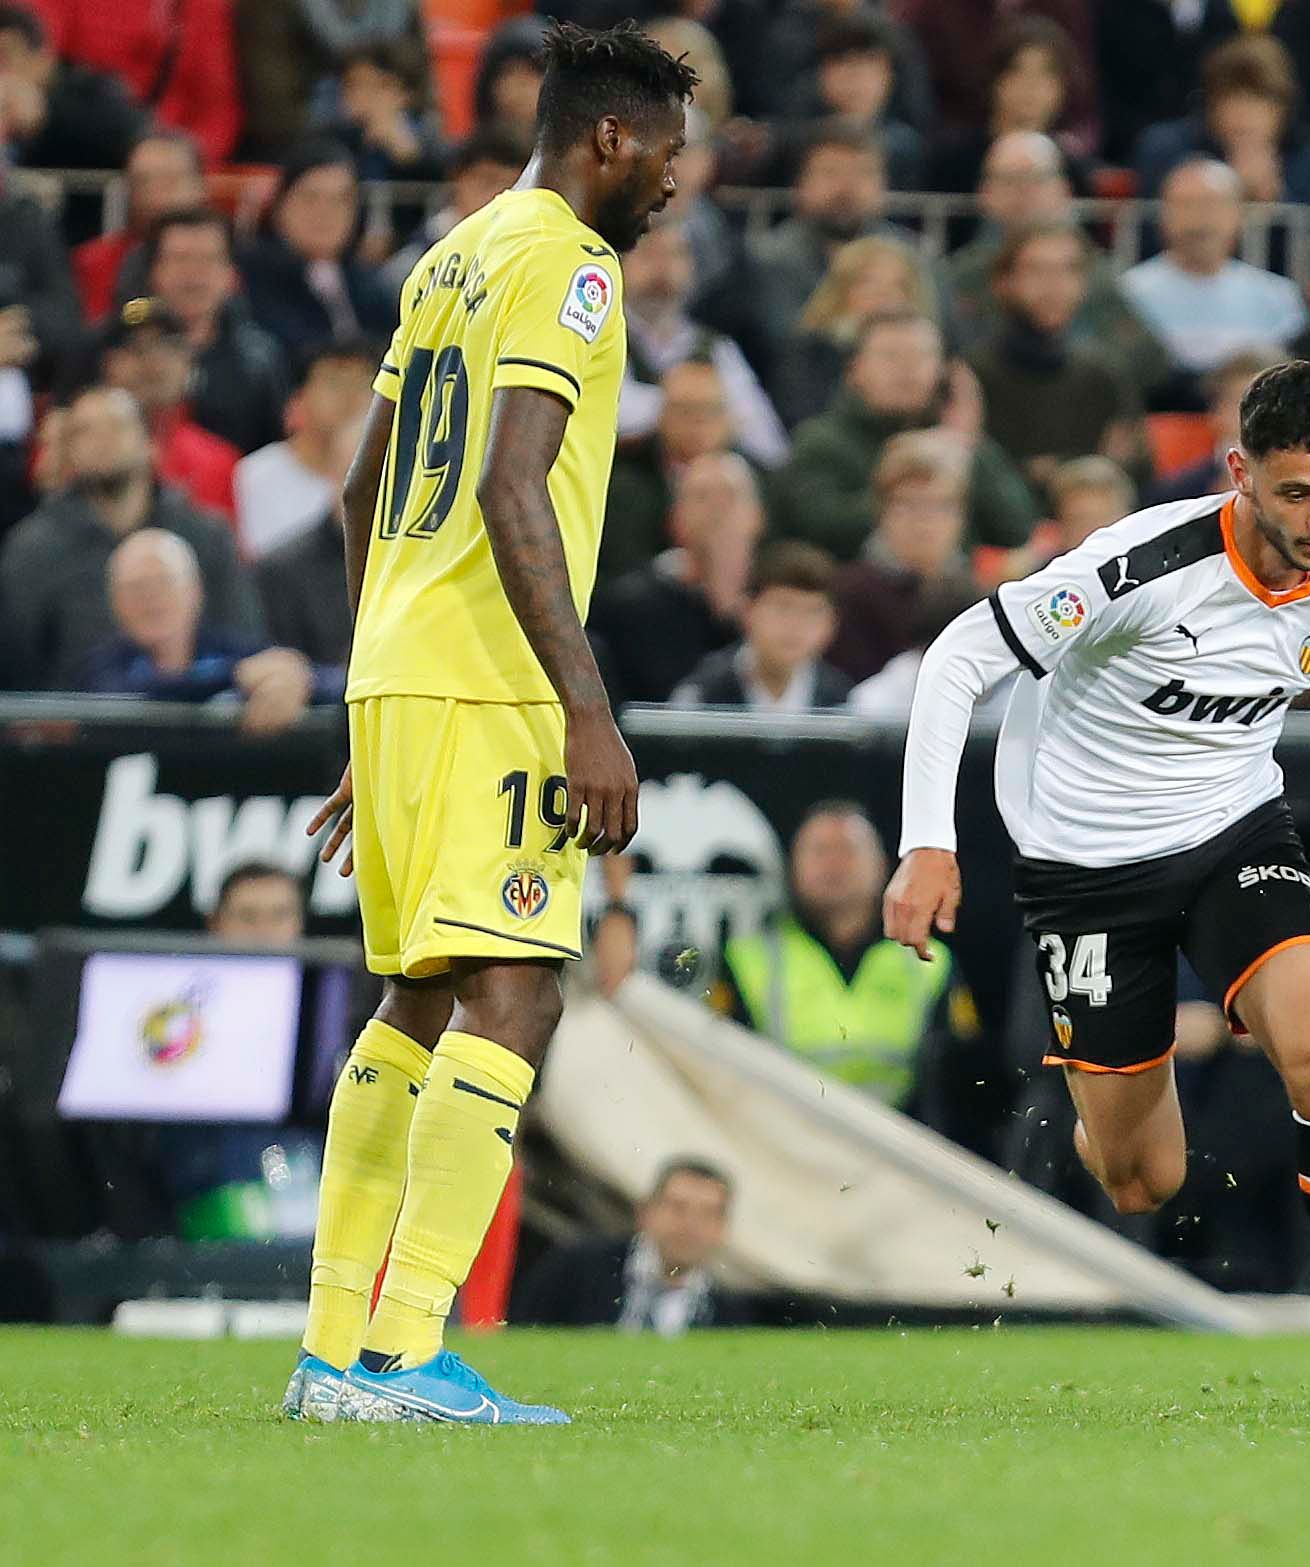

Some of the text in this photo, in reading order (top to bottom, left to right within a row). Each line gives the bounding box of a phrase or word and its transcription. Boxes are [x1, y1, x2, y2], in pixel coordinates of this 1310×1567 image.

[379, 344, 469, 540] 19
[1141, 678, 1289, 726] bwi
[497, 769, 569, 854] 19
[1038, 931, 1113, 1007] 34
